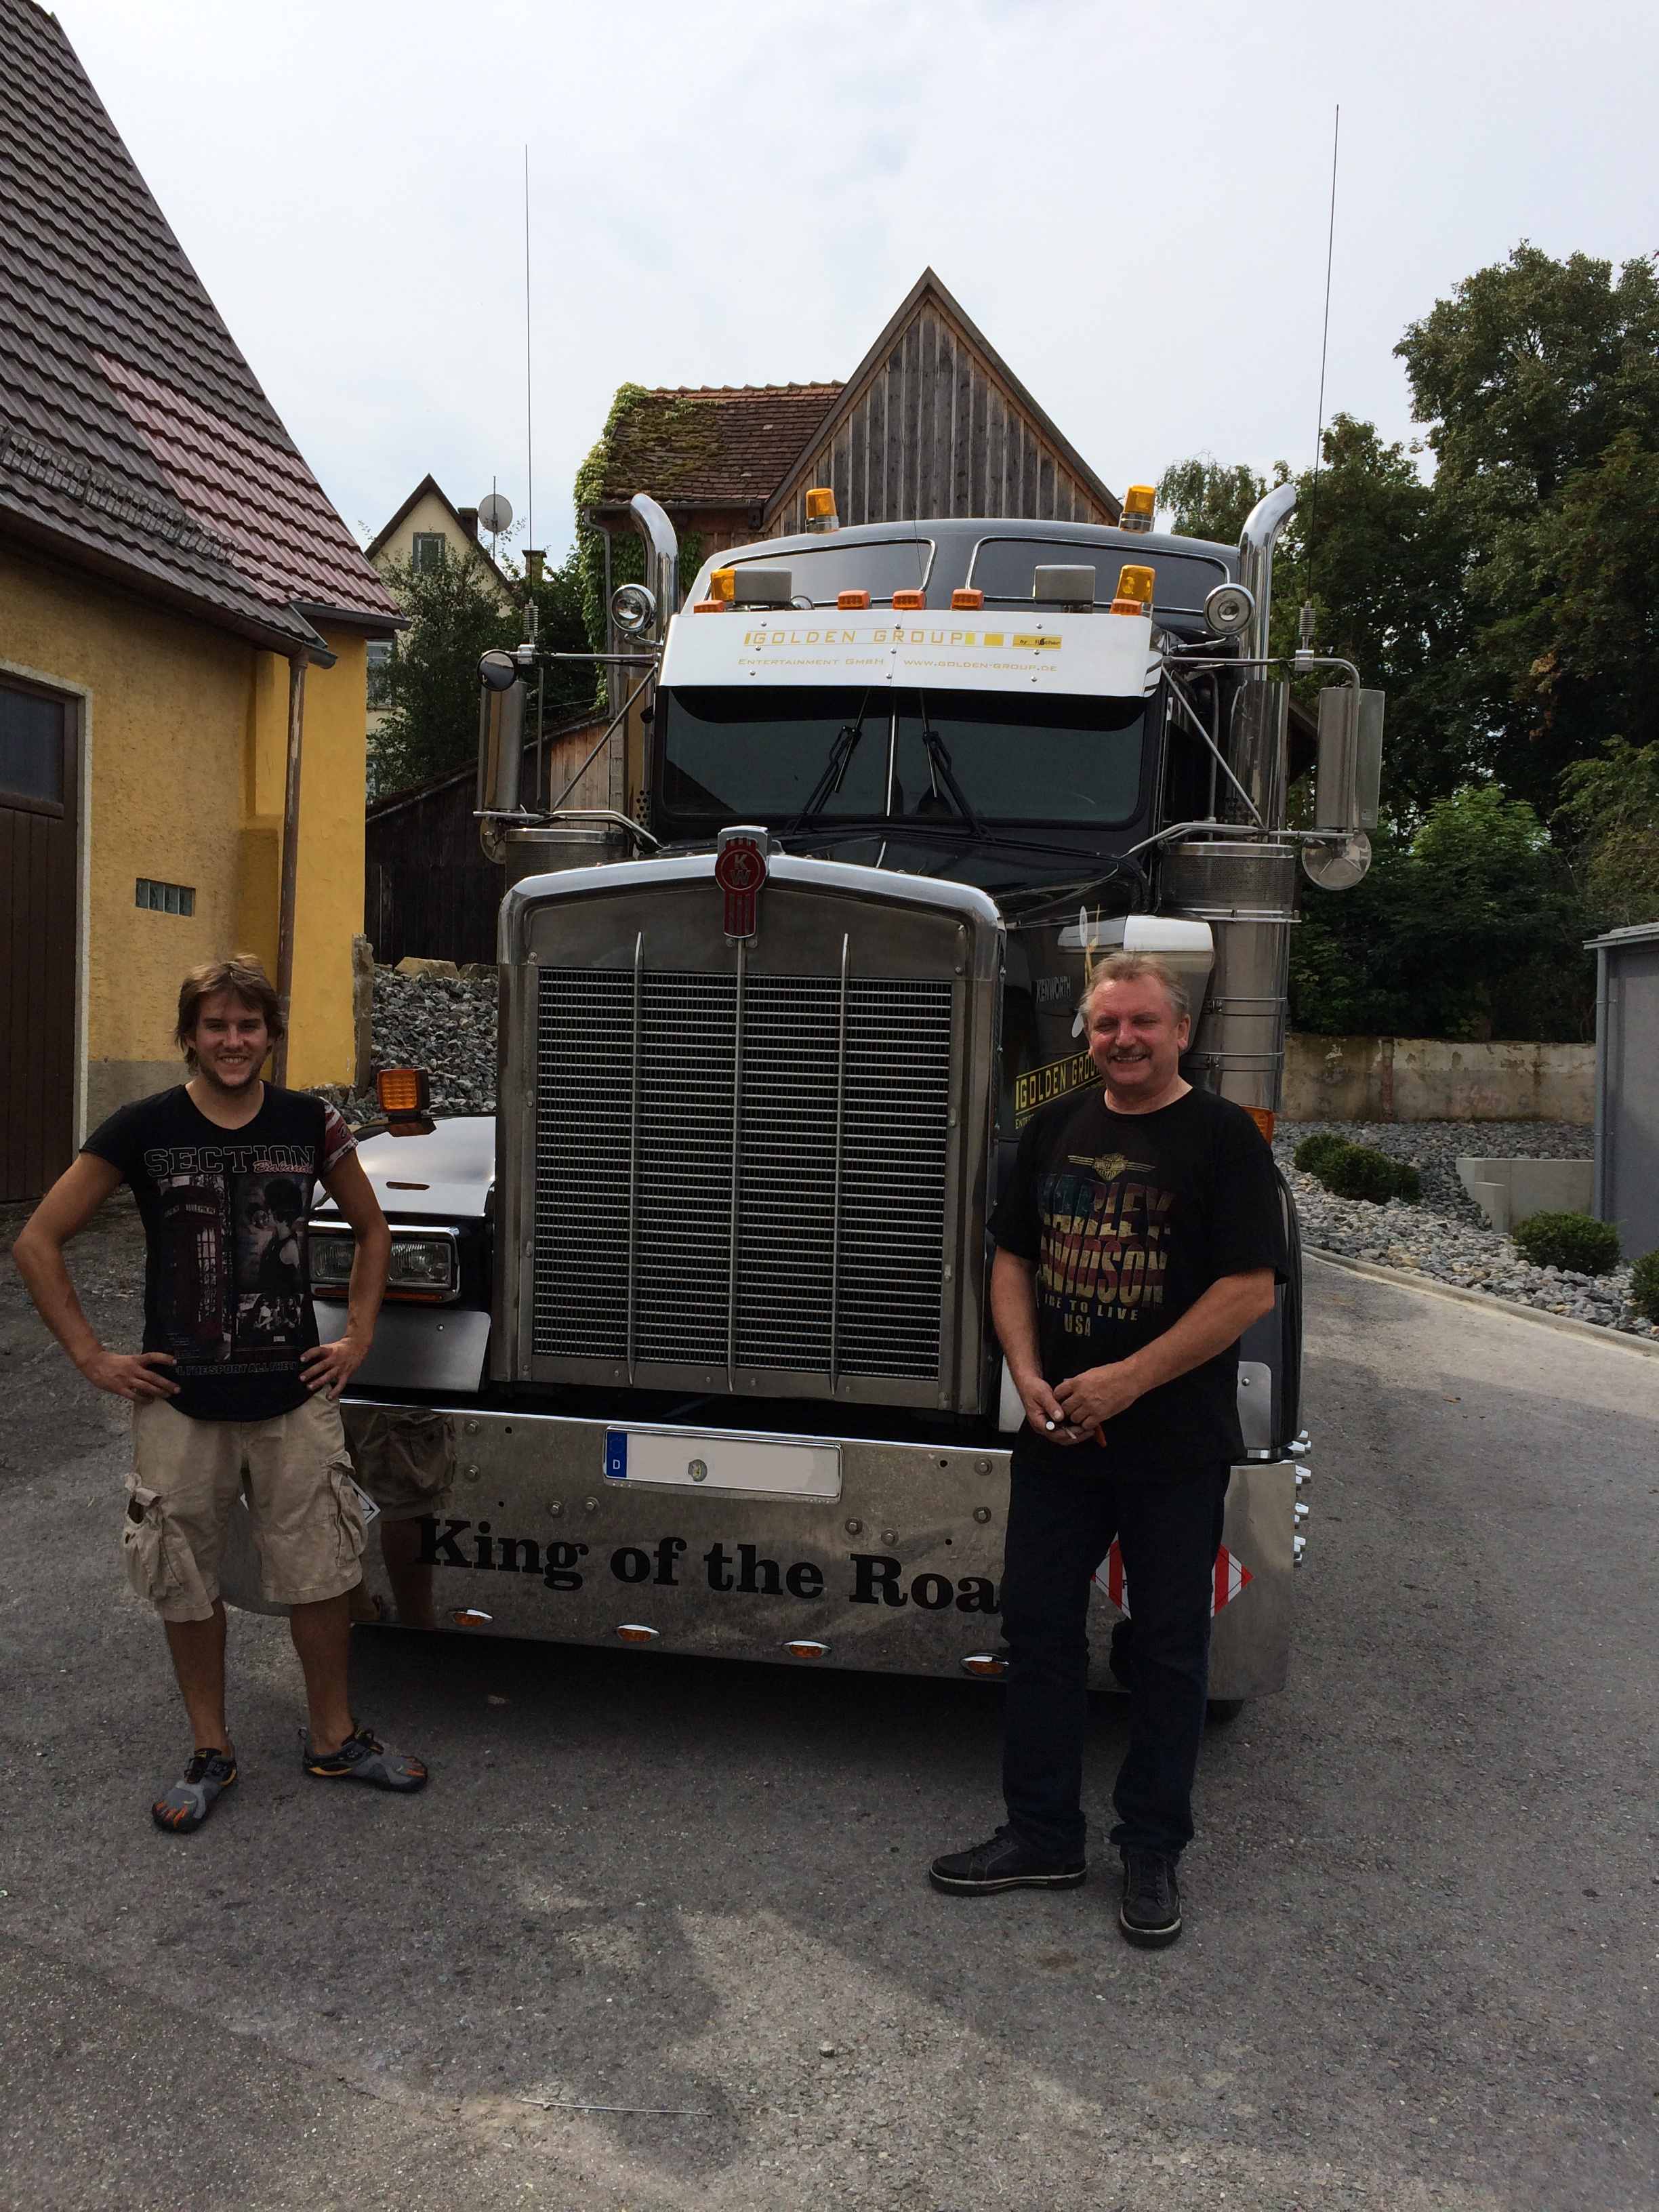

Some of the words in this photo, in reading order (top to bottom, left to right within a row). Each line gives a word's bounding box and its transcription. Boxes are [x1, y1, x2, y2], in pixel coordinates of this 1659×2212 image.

[753, 630, 856, 644] GOLDEN
[873, 630, 963, 644] GROUP
[734, 854, 748, 870] K
[730, 869, 752, 886] W
[1035, 975, 1071, 1004] KENWORTH
[1020, 1063, 1067, 1109] GOLDEN
[1071, 1053, 1099, 1086] GROU
[144, 1144, 316, 1178] SECTION
[1069, 1298, 1089, 1313] TO
[1097, 1304, 1139, 1321] LIVE
[1064, 1313, 1092, 1337] USA
[186, 1365, 208, 1376] THE
[207, 1363, 248, 1375] SPORT
[247, 1362, 269, 1373] ALL
[612, 1458, 621, 1470] D
[414, 1517, 590, 1591] King
[610, 1536, 687, 1586] of
[703, 1542, 825, 1599] the
